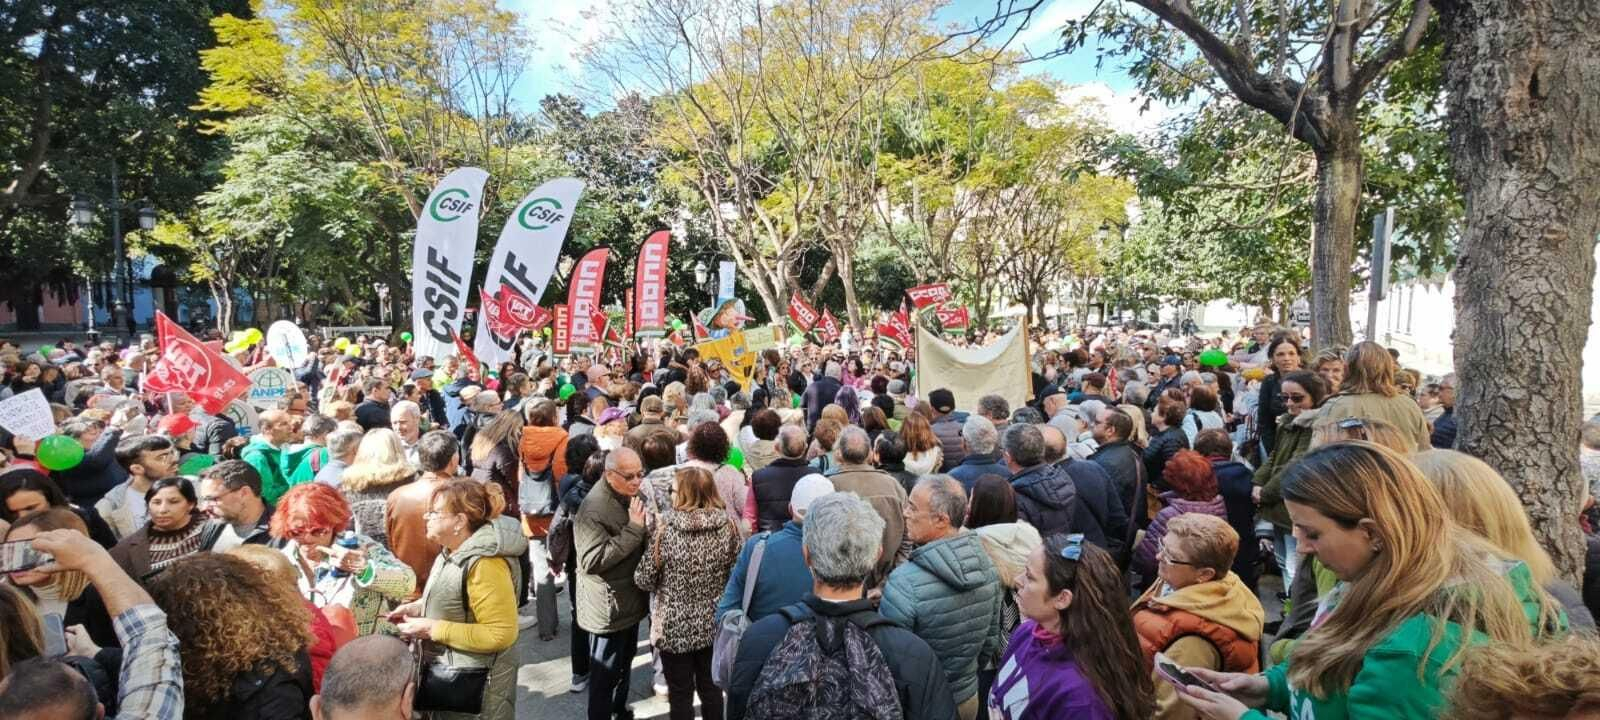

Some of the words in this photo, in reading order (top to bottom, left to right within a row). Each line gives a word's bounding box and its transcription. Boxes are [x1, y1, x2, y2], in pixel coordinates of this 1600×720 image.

[439, 197, 475, 215] CSIF
[528, 205, 566, 225] CSIF
[422, 245, 462, 344] CSIF
